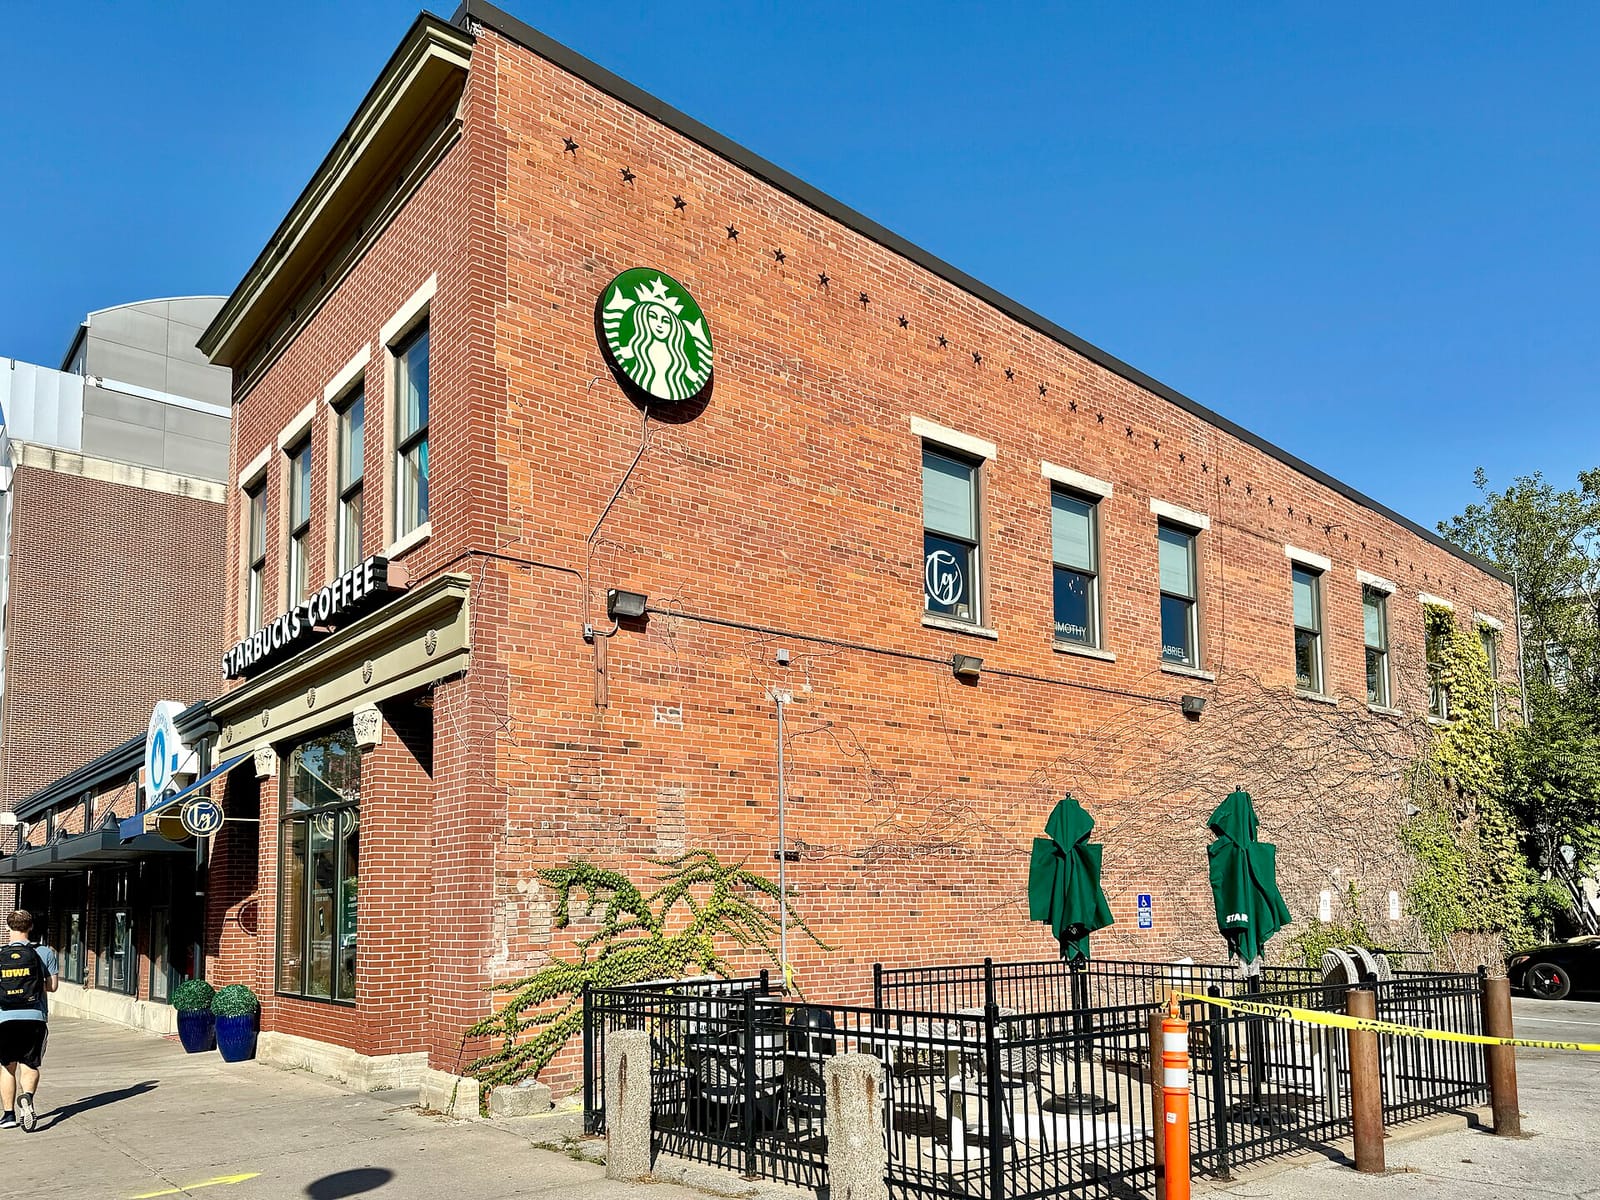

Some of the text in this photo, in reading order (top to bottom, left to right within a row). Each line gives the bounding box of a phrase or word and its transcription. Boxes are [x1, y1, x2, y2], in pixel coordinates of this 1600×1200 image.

[222, 555, 376, 680] STARBUCKS COFFEE
[1226, 913, 1248, 923] STAR
[1, 967, 30, 978] IOWA
